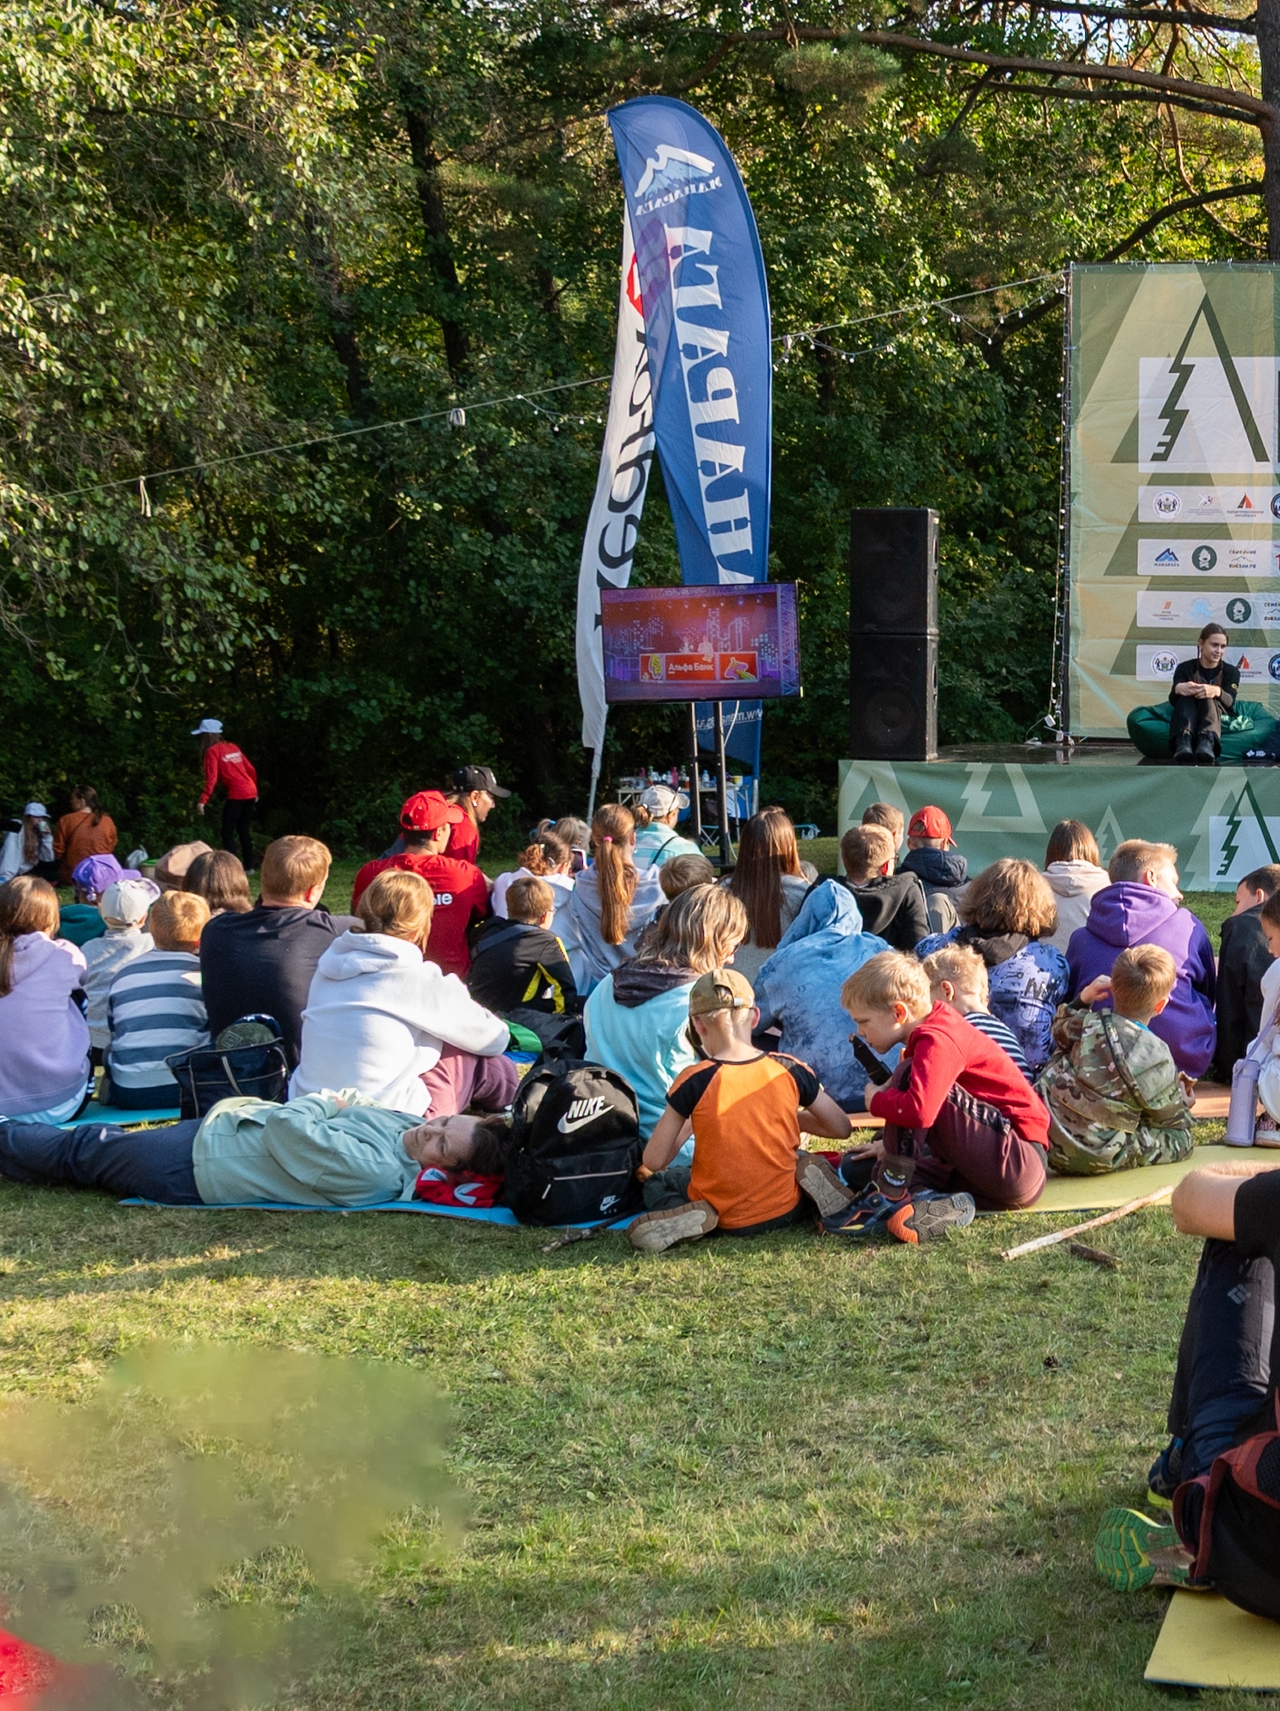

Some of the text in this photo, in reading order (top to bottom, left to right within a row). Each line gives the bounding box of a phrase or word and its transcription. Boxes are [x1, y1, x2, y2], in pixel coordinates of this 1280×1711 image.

[668, 662, 714, 674] Альфа Банк
[567, 1095, 606, 1119] NIKE
